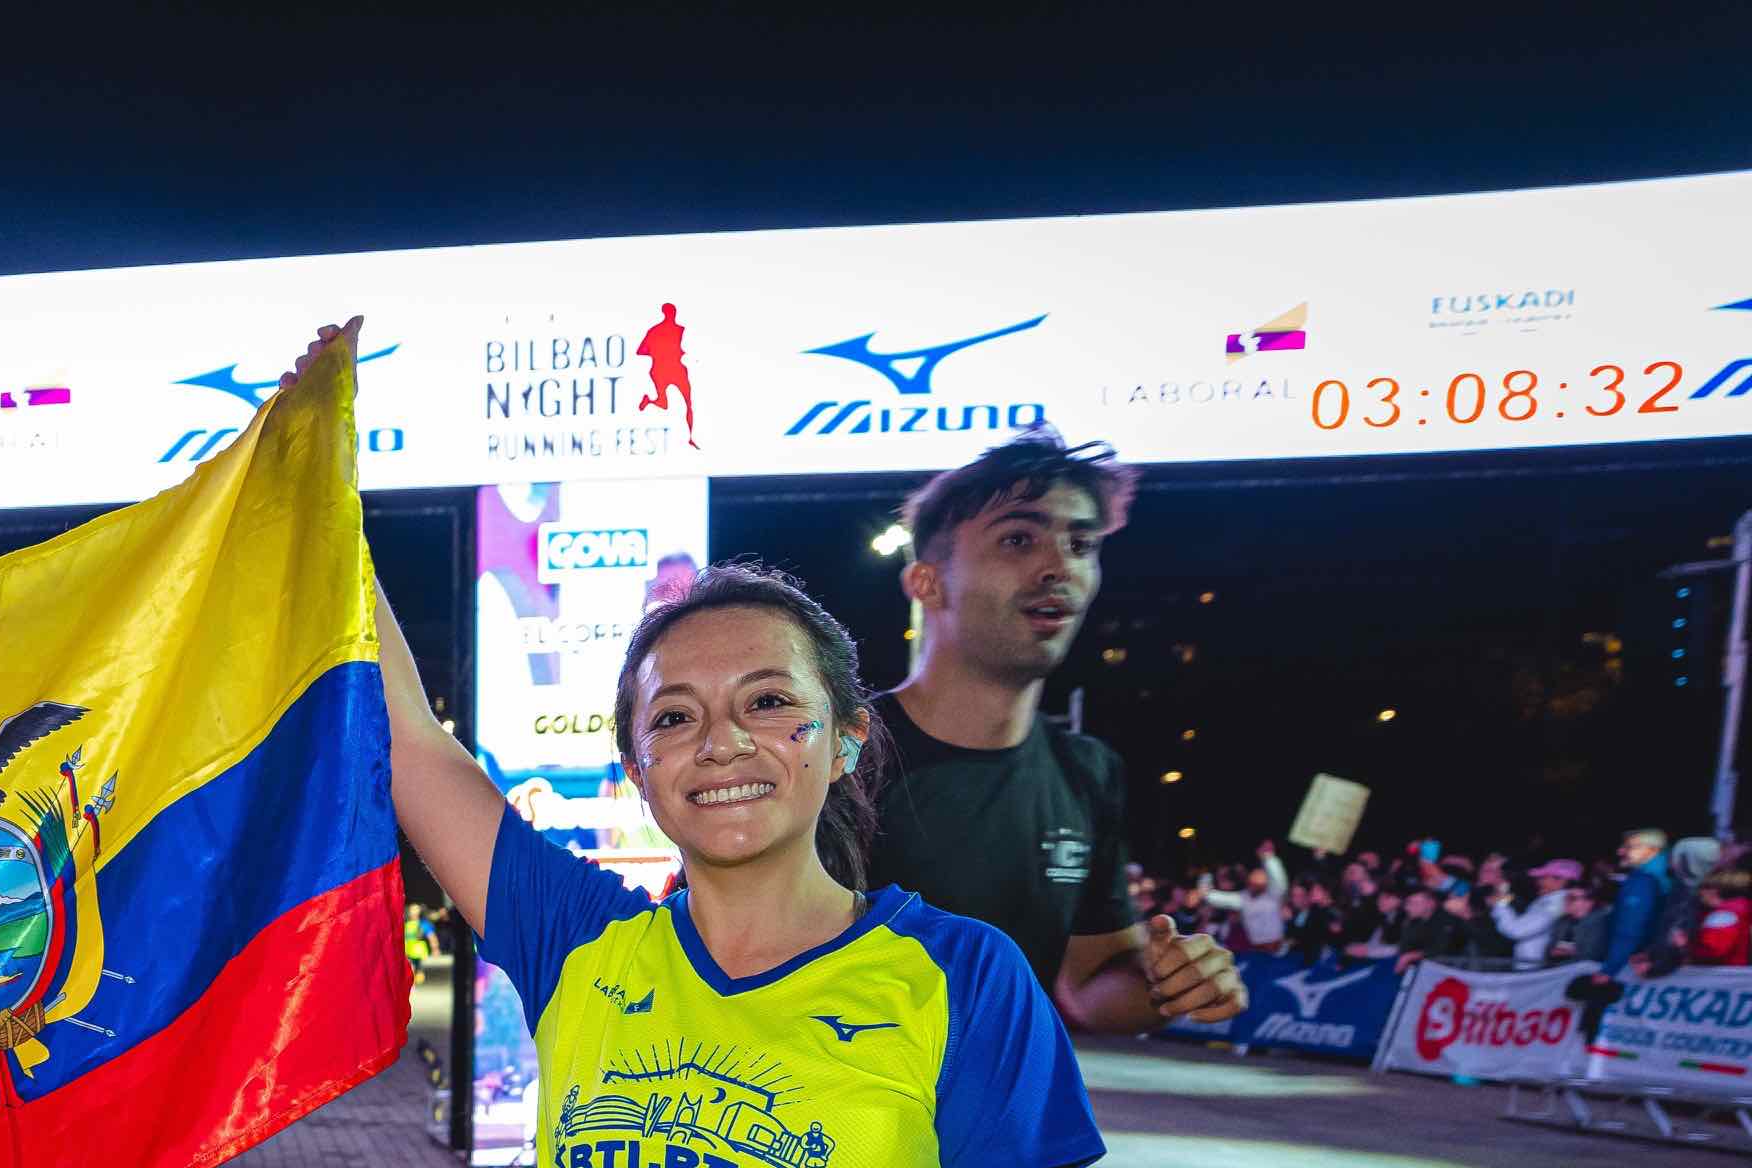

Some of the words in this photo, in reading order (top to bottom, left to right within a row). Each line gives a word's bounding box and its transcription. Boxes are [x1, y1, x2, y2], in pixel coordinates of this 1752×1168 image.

[486, 333, 626, 373] BILBAO
[1310, 359, 1685, 431] 03:08:32
[487, 429, 601, 461] RUNNING
[615, 424, 671, 456] FEST
